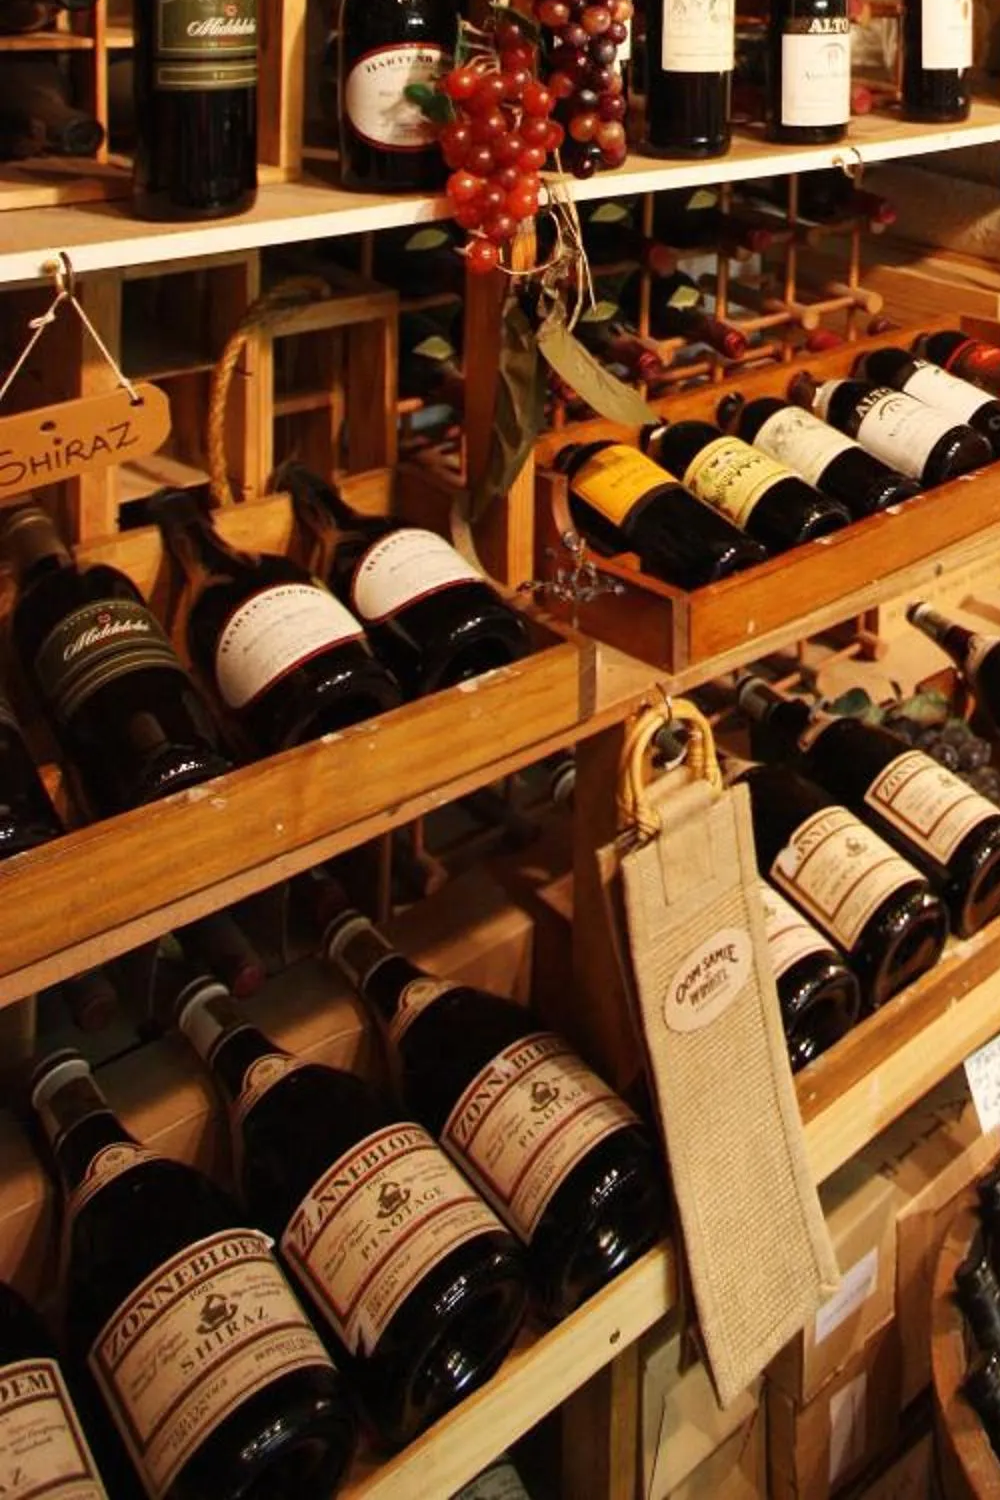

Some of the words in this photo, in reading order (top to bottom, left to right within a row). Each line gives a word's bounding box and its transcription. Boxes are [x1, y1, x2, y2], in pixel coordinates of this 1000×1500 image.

[359, 1184, 443, 1261] PINOTAGE
[103, 1237, 268, 1358] ZONNEBLOEM
[179, 1305, 270, 1376] SHIRAZ
